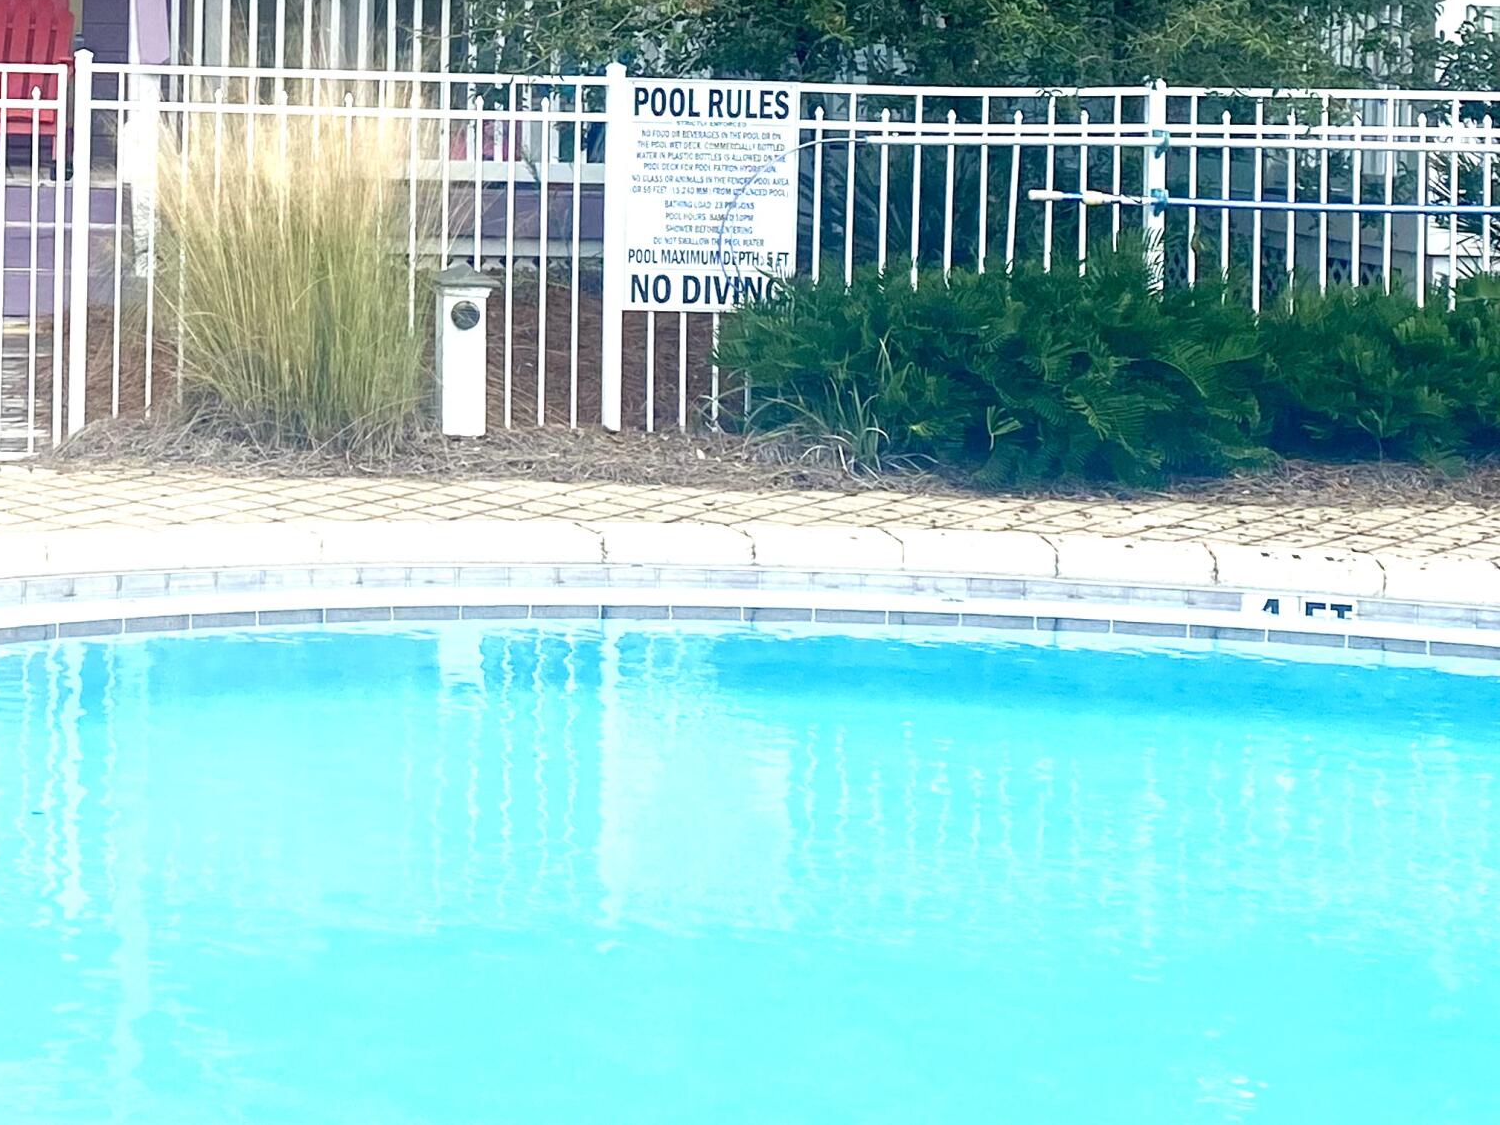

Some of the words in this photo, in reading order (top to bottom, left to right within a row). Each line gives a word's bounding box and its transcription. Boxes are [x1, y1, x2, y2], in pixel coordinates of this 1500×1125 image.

[633, 86, 701, 118] POOL
[708, 88, 790, 120] RULES
[641, 129, 651, 137] NO
[652, 129, 670, 138] FOOD
[671, 130, 680, 138] OR
[682, 130, 720, 139] BEVERAGES
[721, 130, 728, 139] IN
[729, 131, 741, 139] THE
[742, 131, 760, 140] POOL
[761, 132, 770, 140] OR
[637, 140, 649, 148] THE
[650, 141, 667, 149] POOL
[669, 141, 682, 149] WET
[704, 142, 755, 151] COMMERCIALLY
[757, 143, 785, 152] BOTTLED
[636, 151, 657, 159] WATER
[667, 152, 693, 160] PLASTIC
[694, 153, 721, 161] BOTTLES
[731, 153, 762, 162] ALLOWED
[763, 154, 773, 162] ON
[643, 162, 659, 170] POOL
[661, 163, 679, 171] DECK
[680, 163, 694, 171] FOR
[695, 164, 710, 172] POOL
[713, 164, 738, 173] PATRON
[631, 174, 641, 182] NO
[642, 175, 663, 183] GLASS
[664, 175, 674, 183] OR
[675, 175, 704, 184] ANIMALS
[705, 176, 712, 184] IN
[713, 176, 725, 184] THE
[753, 177, 770, 185] POOL
[772, 178, 789, 186] AREA
[652, 185, 667, 194] FEET
[712, 187, 731, 196] FROM
[664, 200, 693, 209] BATHING
[665, 212, 682, 220] POOL
[665, 224, 693, 233] SHOWER
[652, 236, 662, 245] DO
[664, 236, 677, 245] NOT
[677, 237, 710, 246] SWALLOW
[742, 239, 765, 247] WATER
[628, 248, 658, 264] POOL
[660, 249, 721, 265] MAXIMUM
[766, 251, 774, 267] 5
[777, 251, 790, 267] FT
[630, 273, 672, 304] NO
